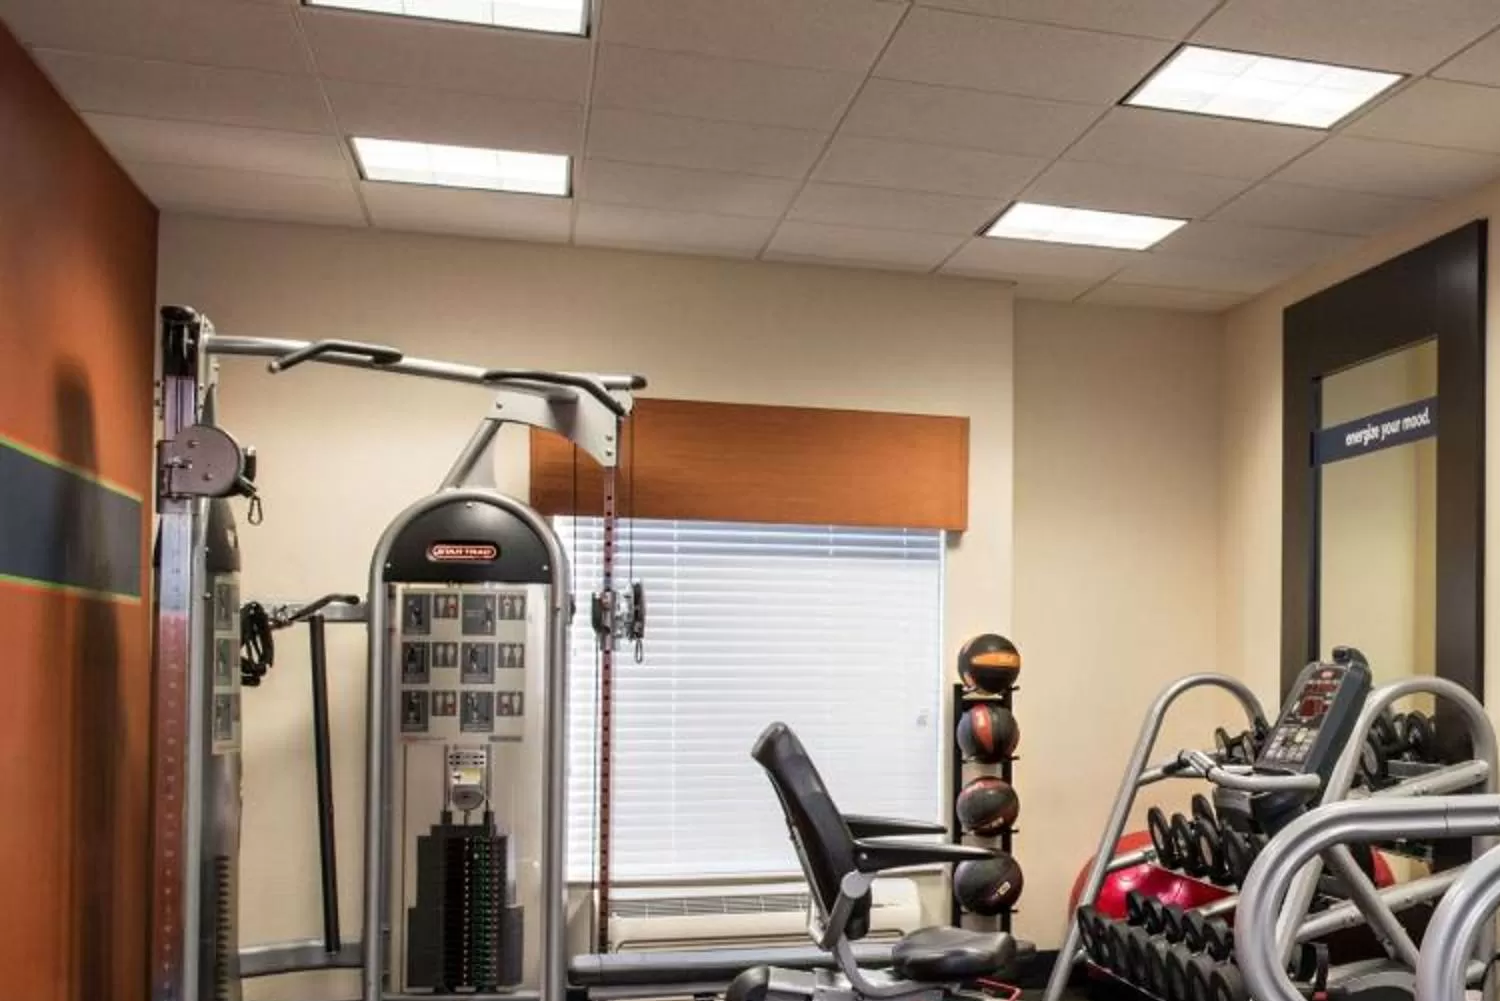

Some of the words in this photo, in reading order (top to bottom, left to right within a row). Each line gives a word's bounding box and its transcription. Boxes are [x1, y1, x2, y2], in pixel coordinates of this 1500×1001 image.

[1345, 423, 1379, 446] energize
[1381, 420, 1401, 441] your
[1402, 406, 1431, 432] mood.
